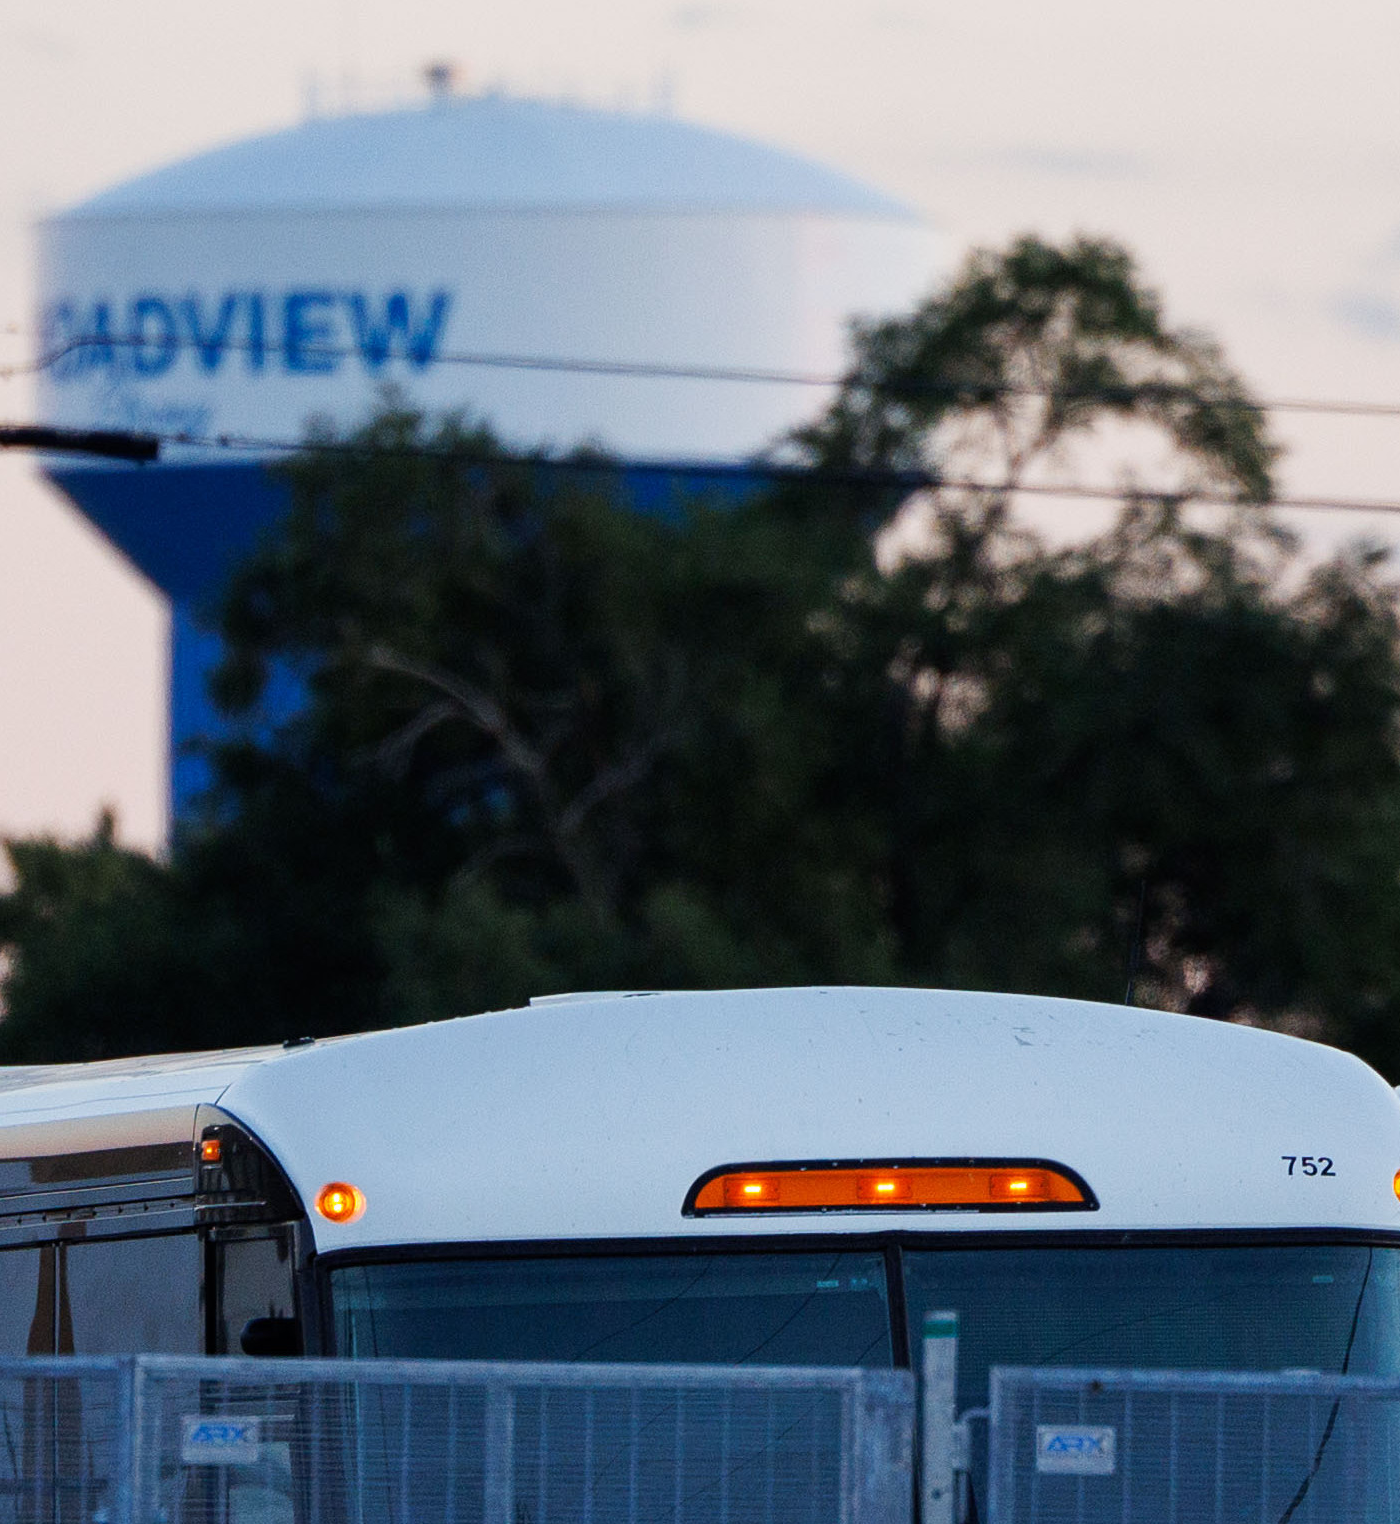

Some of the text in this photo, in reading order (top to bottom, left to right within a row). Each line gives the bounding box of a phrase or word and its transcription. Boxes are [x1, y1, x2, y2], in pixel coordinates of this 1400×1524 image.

[1281, 1155, 1337, 1177] 752
[190, 1423, 250, 1443] ARX
[1046, 1435, 1105, 1454] ARX
